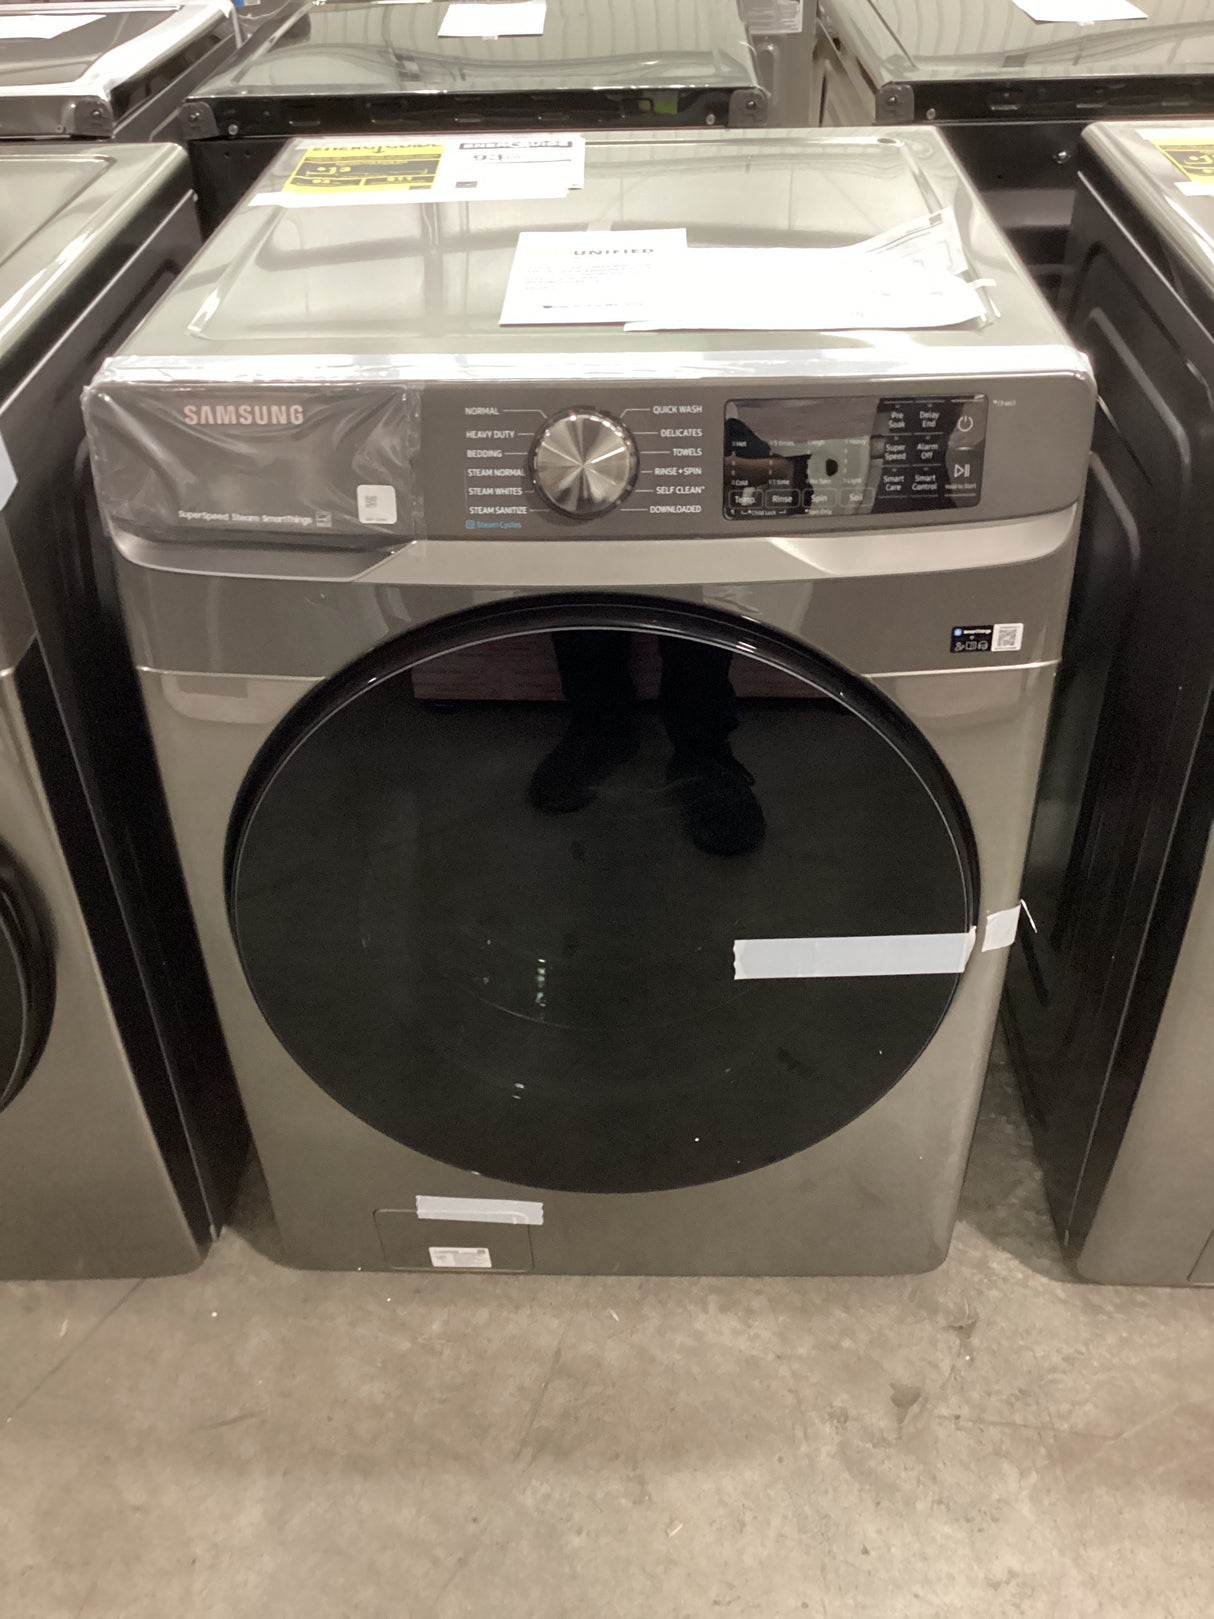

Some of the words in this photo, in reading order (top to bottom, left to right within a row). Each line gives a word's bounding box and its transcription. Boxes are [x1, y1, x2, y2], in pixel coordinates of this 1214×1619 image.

[464, 407, 500, 416] NORMAL
[653, 405, 678, 414] QUICK
[679, 405, 703, 414] WASH
[183, 404, 305, 425] SAMSUNG
[891, 411, 904, 420] Pre
[919, 410, 940, 420] Delay
[888, 419, 905, 428] Soak
[922, 420, 936, 428] End
[466, 430, 492, 439] HEAVY
[493, 430, 515, 438] DUTY
[660, 428, 703, 437] DELICATES
[886, 443, 906, 453] Super
[917, 443, 939, 451] Alarm
[466, 449, 502, 458] BEDDING
[672, 448, 703, 456] TOWELS
[885, 452, 907, 461] Speed
[921, 451, 934, 460] Off
[467, 468, 492, 477] STEAM
[494, 468, 525, 477] NORMAL
[883, 475, 905, 483] Smart
[915, 474, 936, 483] Smart
[656, 486, 675, 495] SELF
[885, 482, 902, 491] Care
[912, 482, 938, 491] Control
[468, 487, 494, 496] STEAM
[495, 487, 523, 496] WHITES
[771, 495, 793, 503] Rinse
[811, 494, 828, 503] Spin
[848, 493, 863, 501] Soil
[469, 506, 495, 515] STEAM
[495, 506, 528, 515] SANITIZE
[649, 505, 702, 514] DOWNLOADED
[178, 510, 230, 521] SuperSpeed
[261, 514, 313, 527] SmartThings
